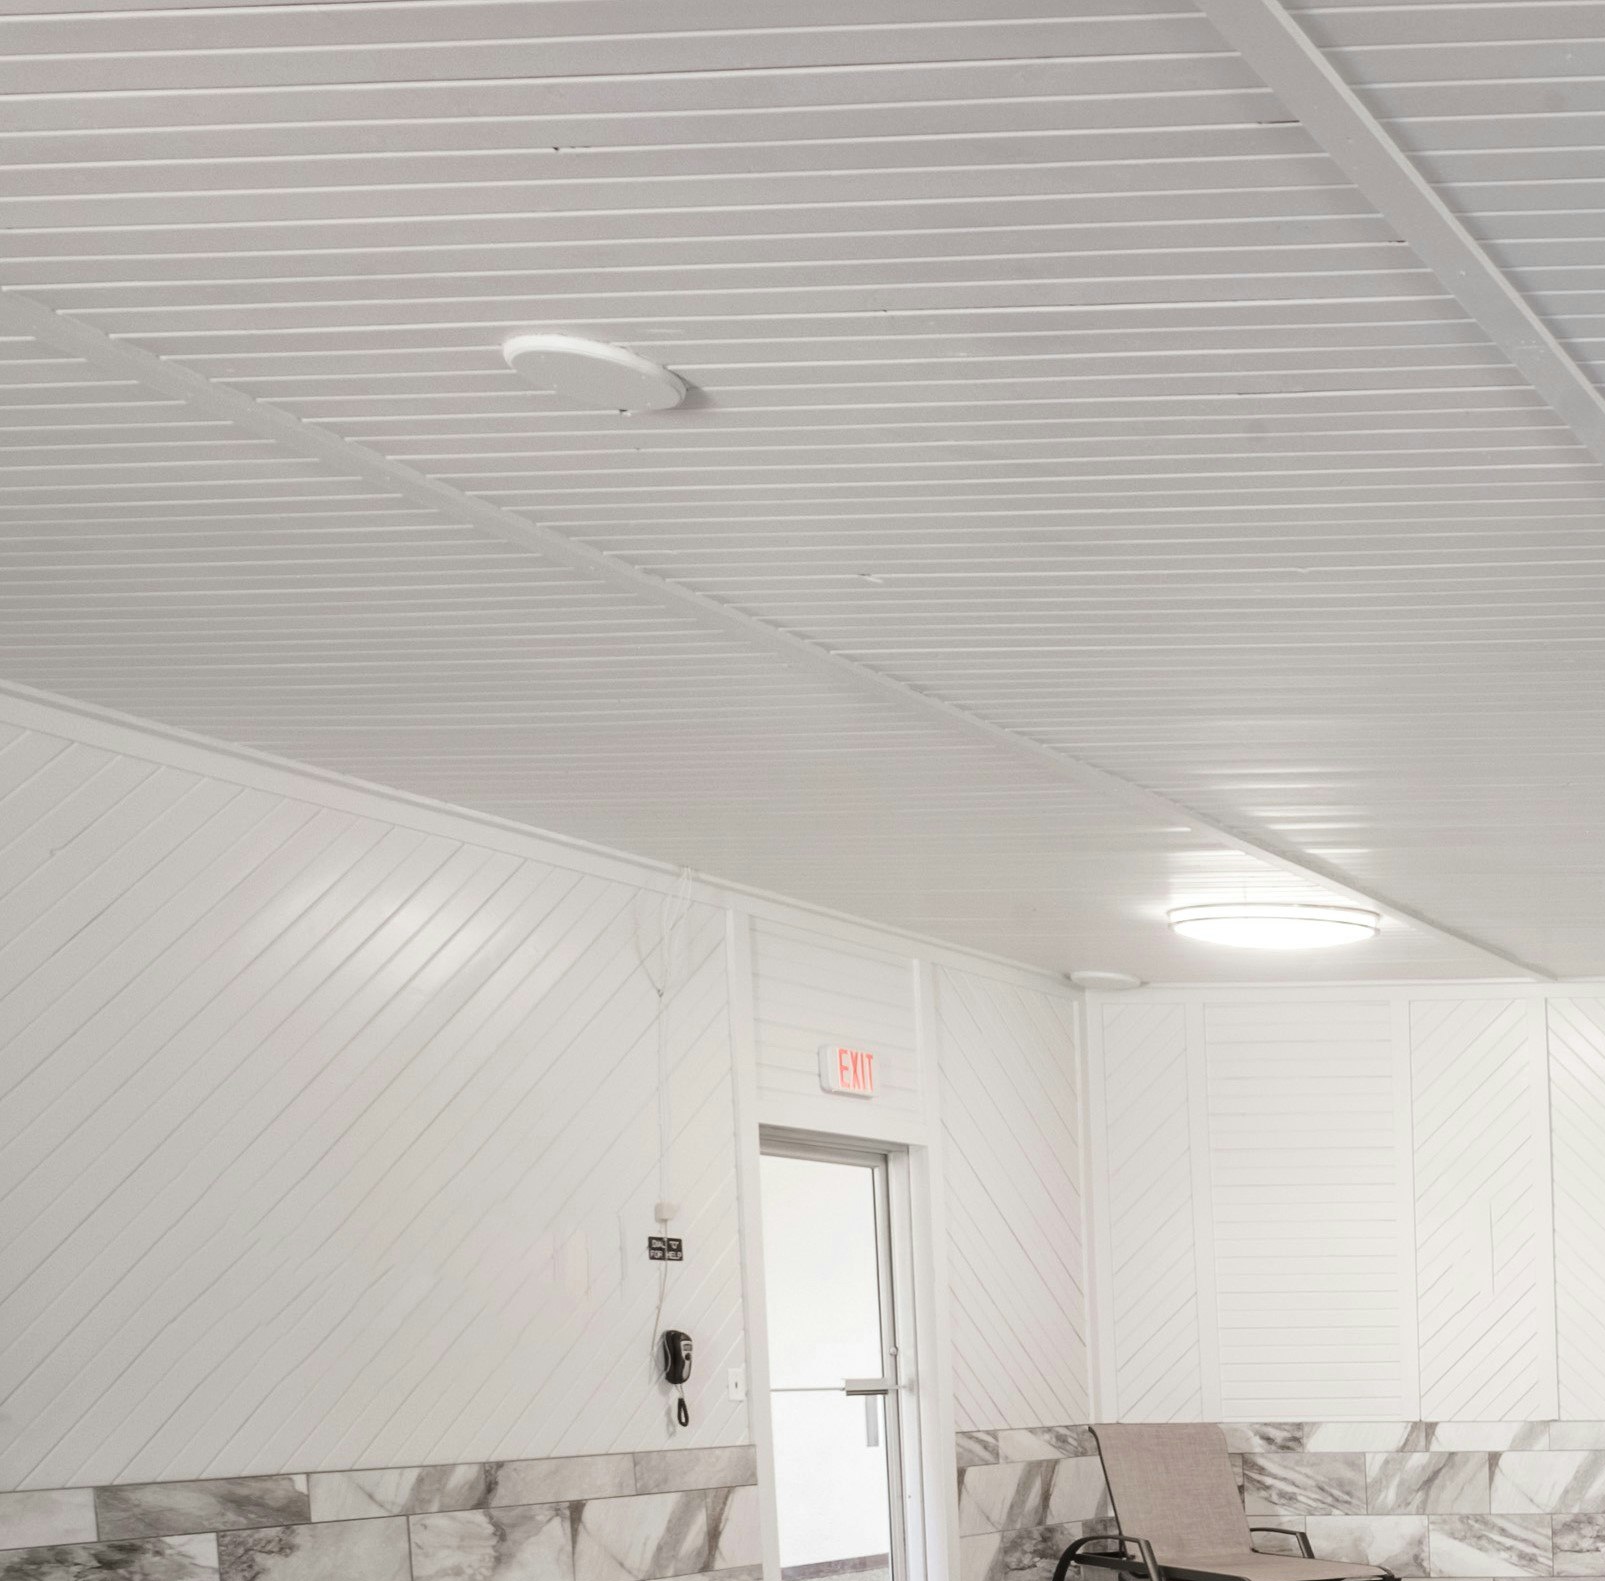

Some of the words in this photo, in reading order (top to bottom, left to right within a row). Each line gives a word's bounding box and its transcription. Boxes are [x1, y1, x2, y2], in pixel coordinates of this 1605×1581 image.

[838, 1048, 873, 1092] EXIT
[650, 1250, 663, 1258] FOR
[666, 1251, 682, 1260] HELP
